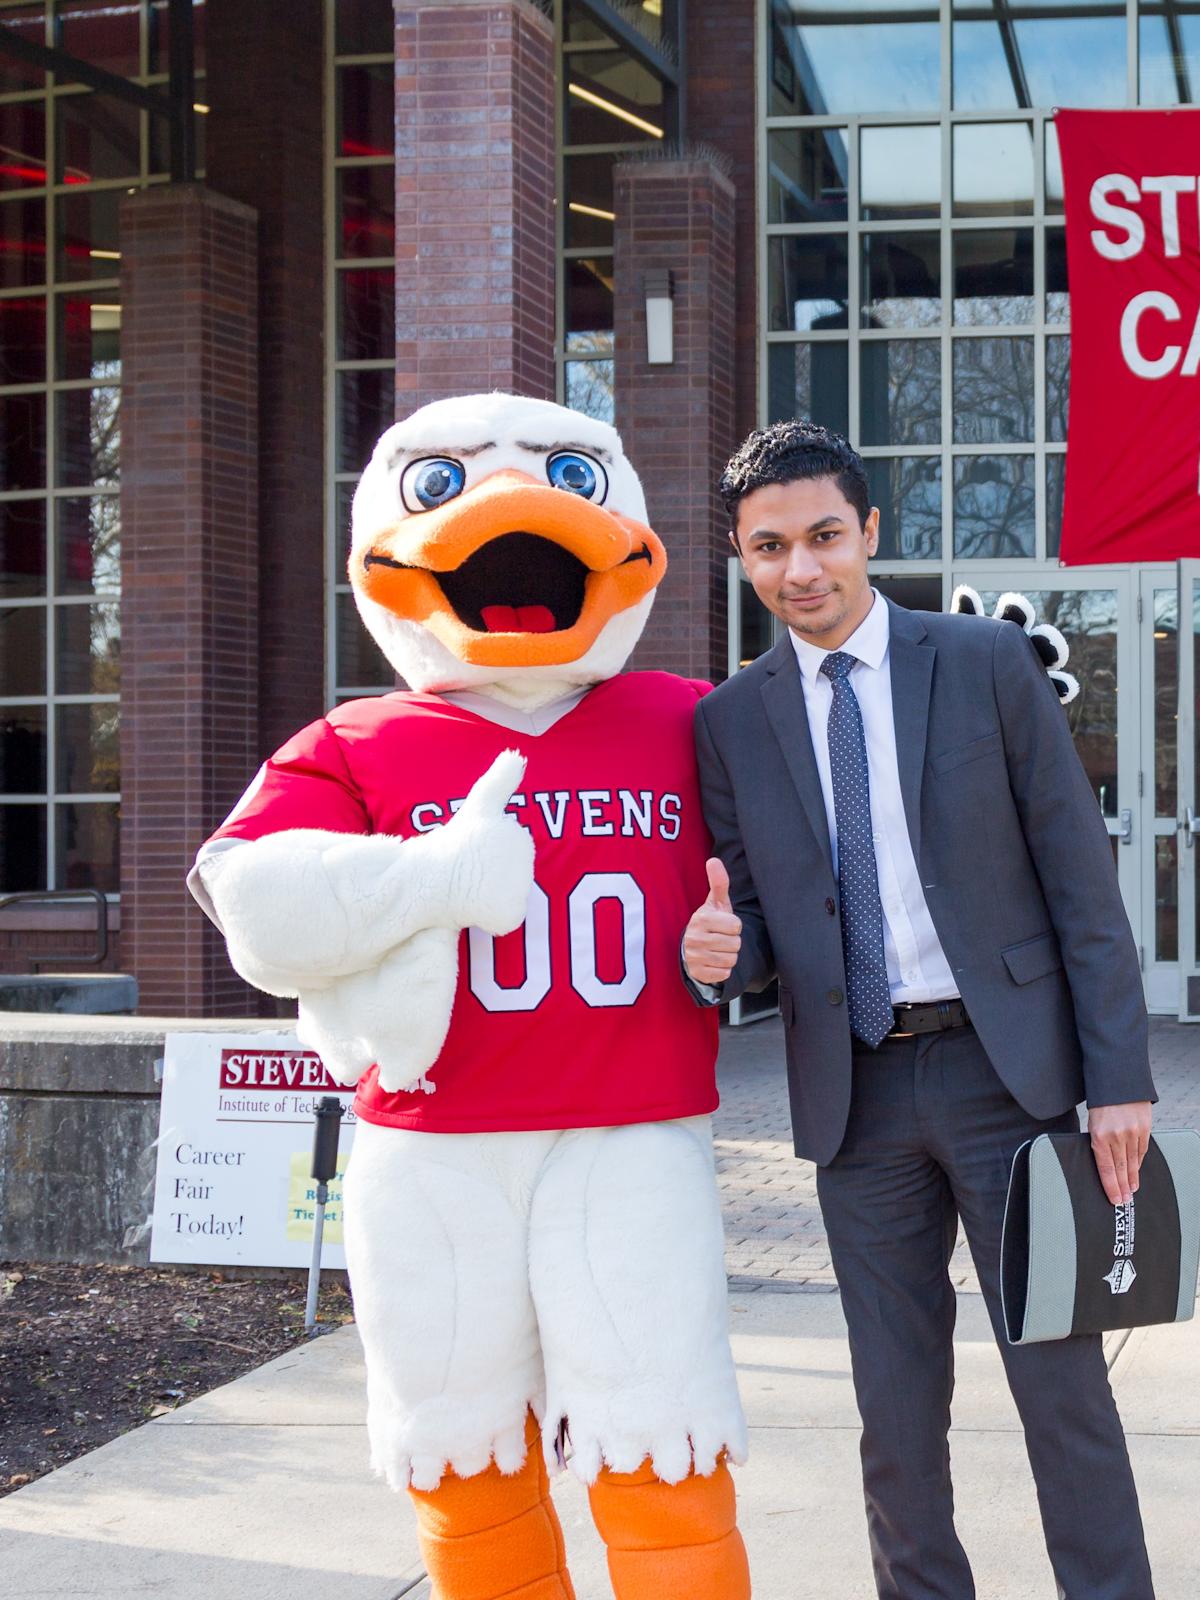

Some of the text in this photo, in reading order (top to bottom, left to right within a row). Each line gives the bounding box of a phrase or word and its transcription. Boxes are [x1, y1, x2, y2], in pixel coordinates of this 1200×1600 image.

[410, 788, 683, 841] SVENS
[468, 871, 647, 1013] 00
[225, 1054, 358, 1088] STEVEN
[218, 1095, 270, 1113] Institute
[274, 1096, 289, 1113] of
[175, 1143, 246, 1166] Career
[174, 1178, 214, 1200] Fair
[171, 1212, 244, 1240] Today!
[293, 1208, 337, 1221] Ticet
